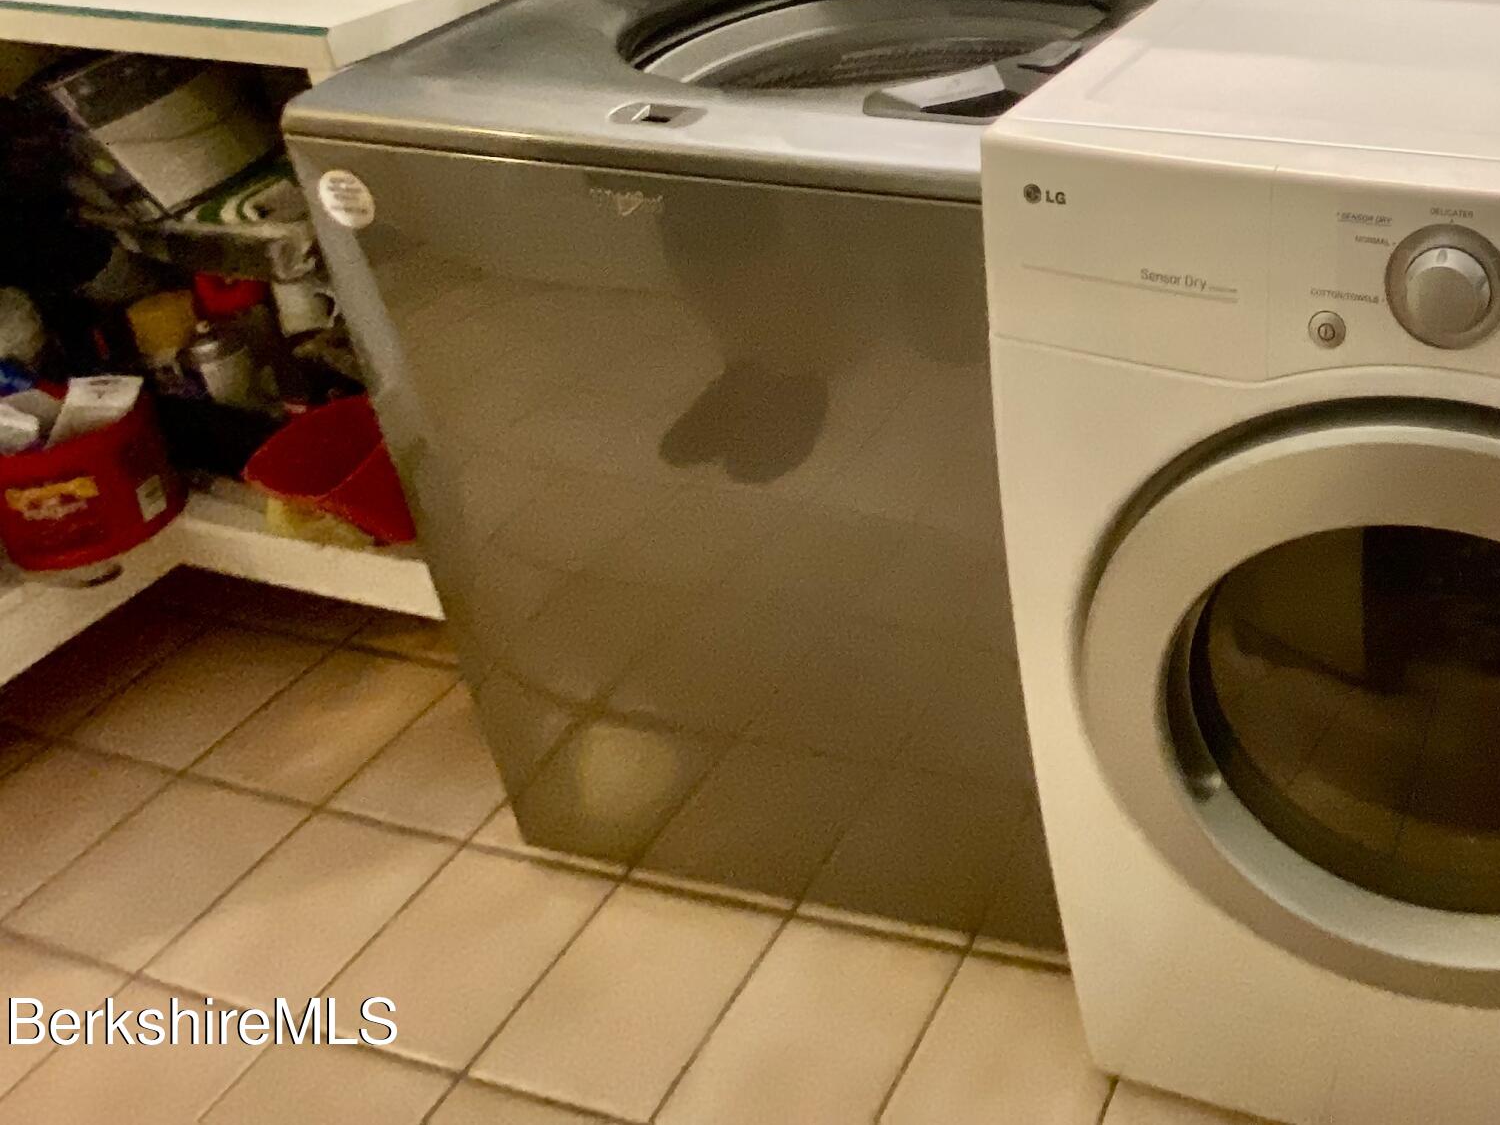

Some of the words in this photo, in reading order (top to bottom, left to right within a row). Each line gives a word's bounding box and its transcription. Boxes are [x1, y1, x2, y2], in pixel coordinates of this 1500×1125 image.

[1045, 190, 1067, 205] LG
[1140, 267, 1182, 286] Sensor
[1184, 274, 1208, 291] Dry
